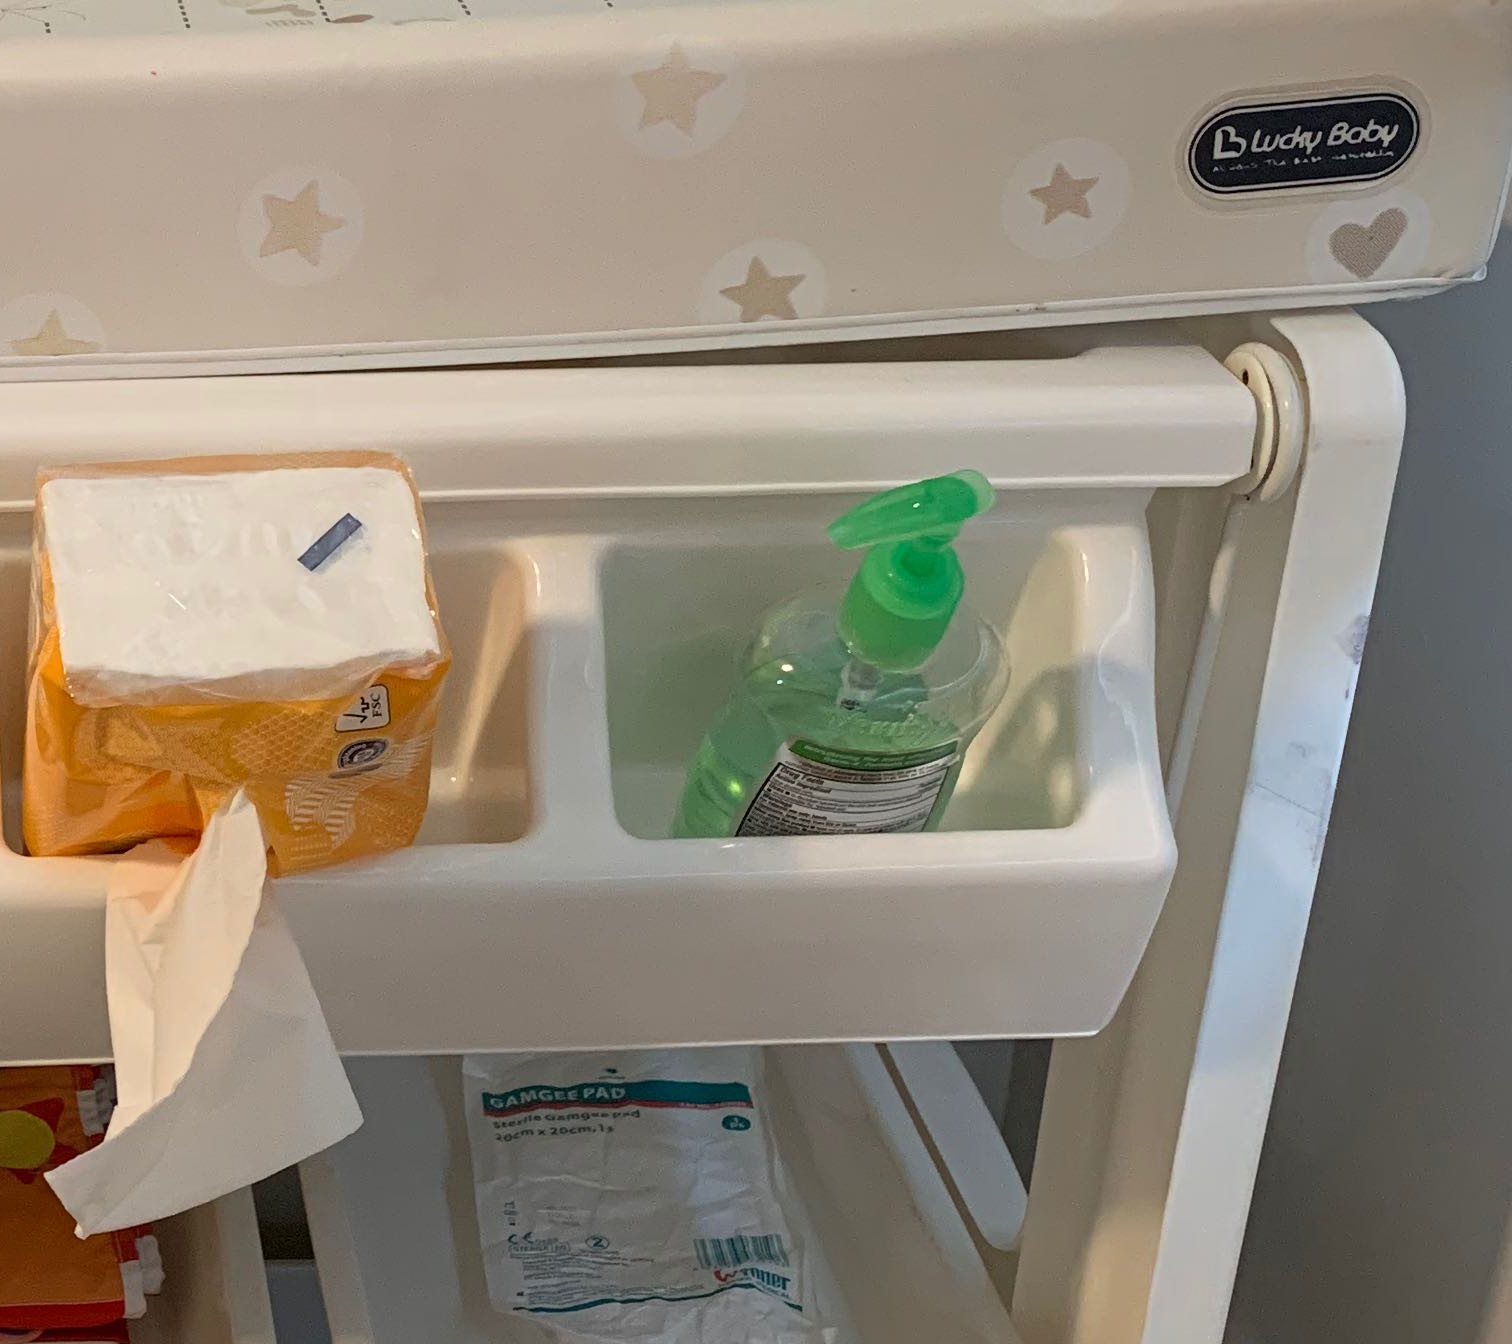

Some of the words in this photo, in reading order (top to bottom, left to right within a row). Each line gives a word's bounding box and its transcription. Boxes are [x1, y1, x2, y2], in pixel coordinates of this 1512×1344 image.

[1251, 125, 1322, 154] Lucky
[1327, 119, 1399, 147] Baby
[370, 693, 382, 717] FSC
[489, 1088, 579, 1109] GAMGEE
[583, 1086, 626, 1099] PAD
